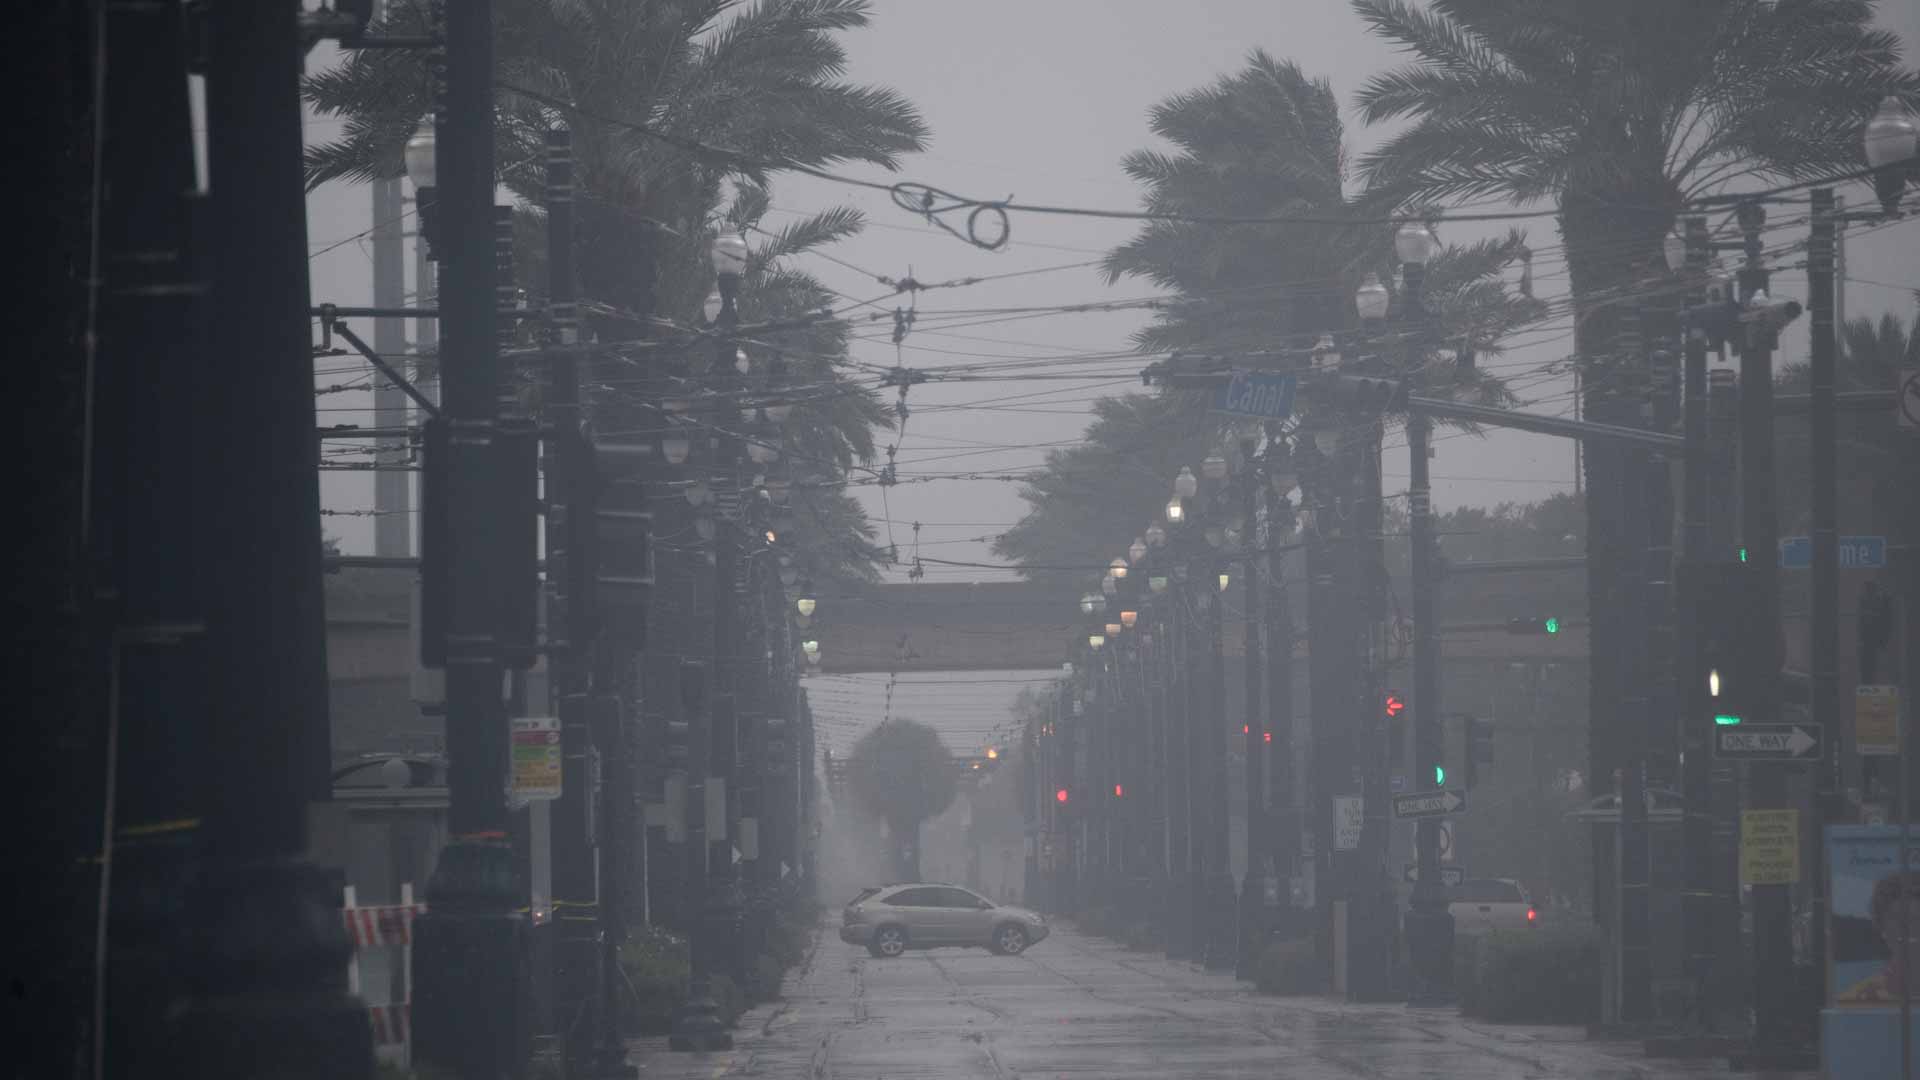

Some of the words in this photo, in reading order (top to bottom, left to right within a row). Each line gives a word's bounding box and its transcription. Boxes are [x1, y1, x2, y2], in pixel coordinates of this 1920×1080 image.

[1225, 376, 1286, 415] Canal
[1726, 735, 1754, 748] ONE
[1759, 735, 1791, 748] WAY
[1423, 799, 1442, 809] WAY
